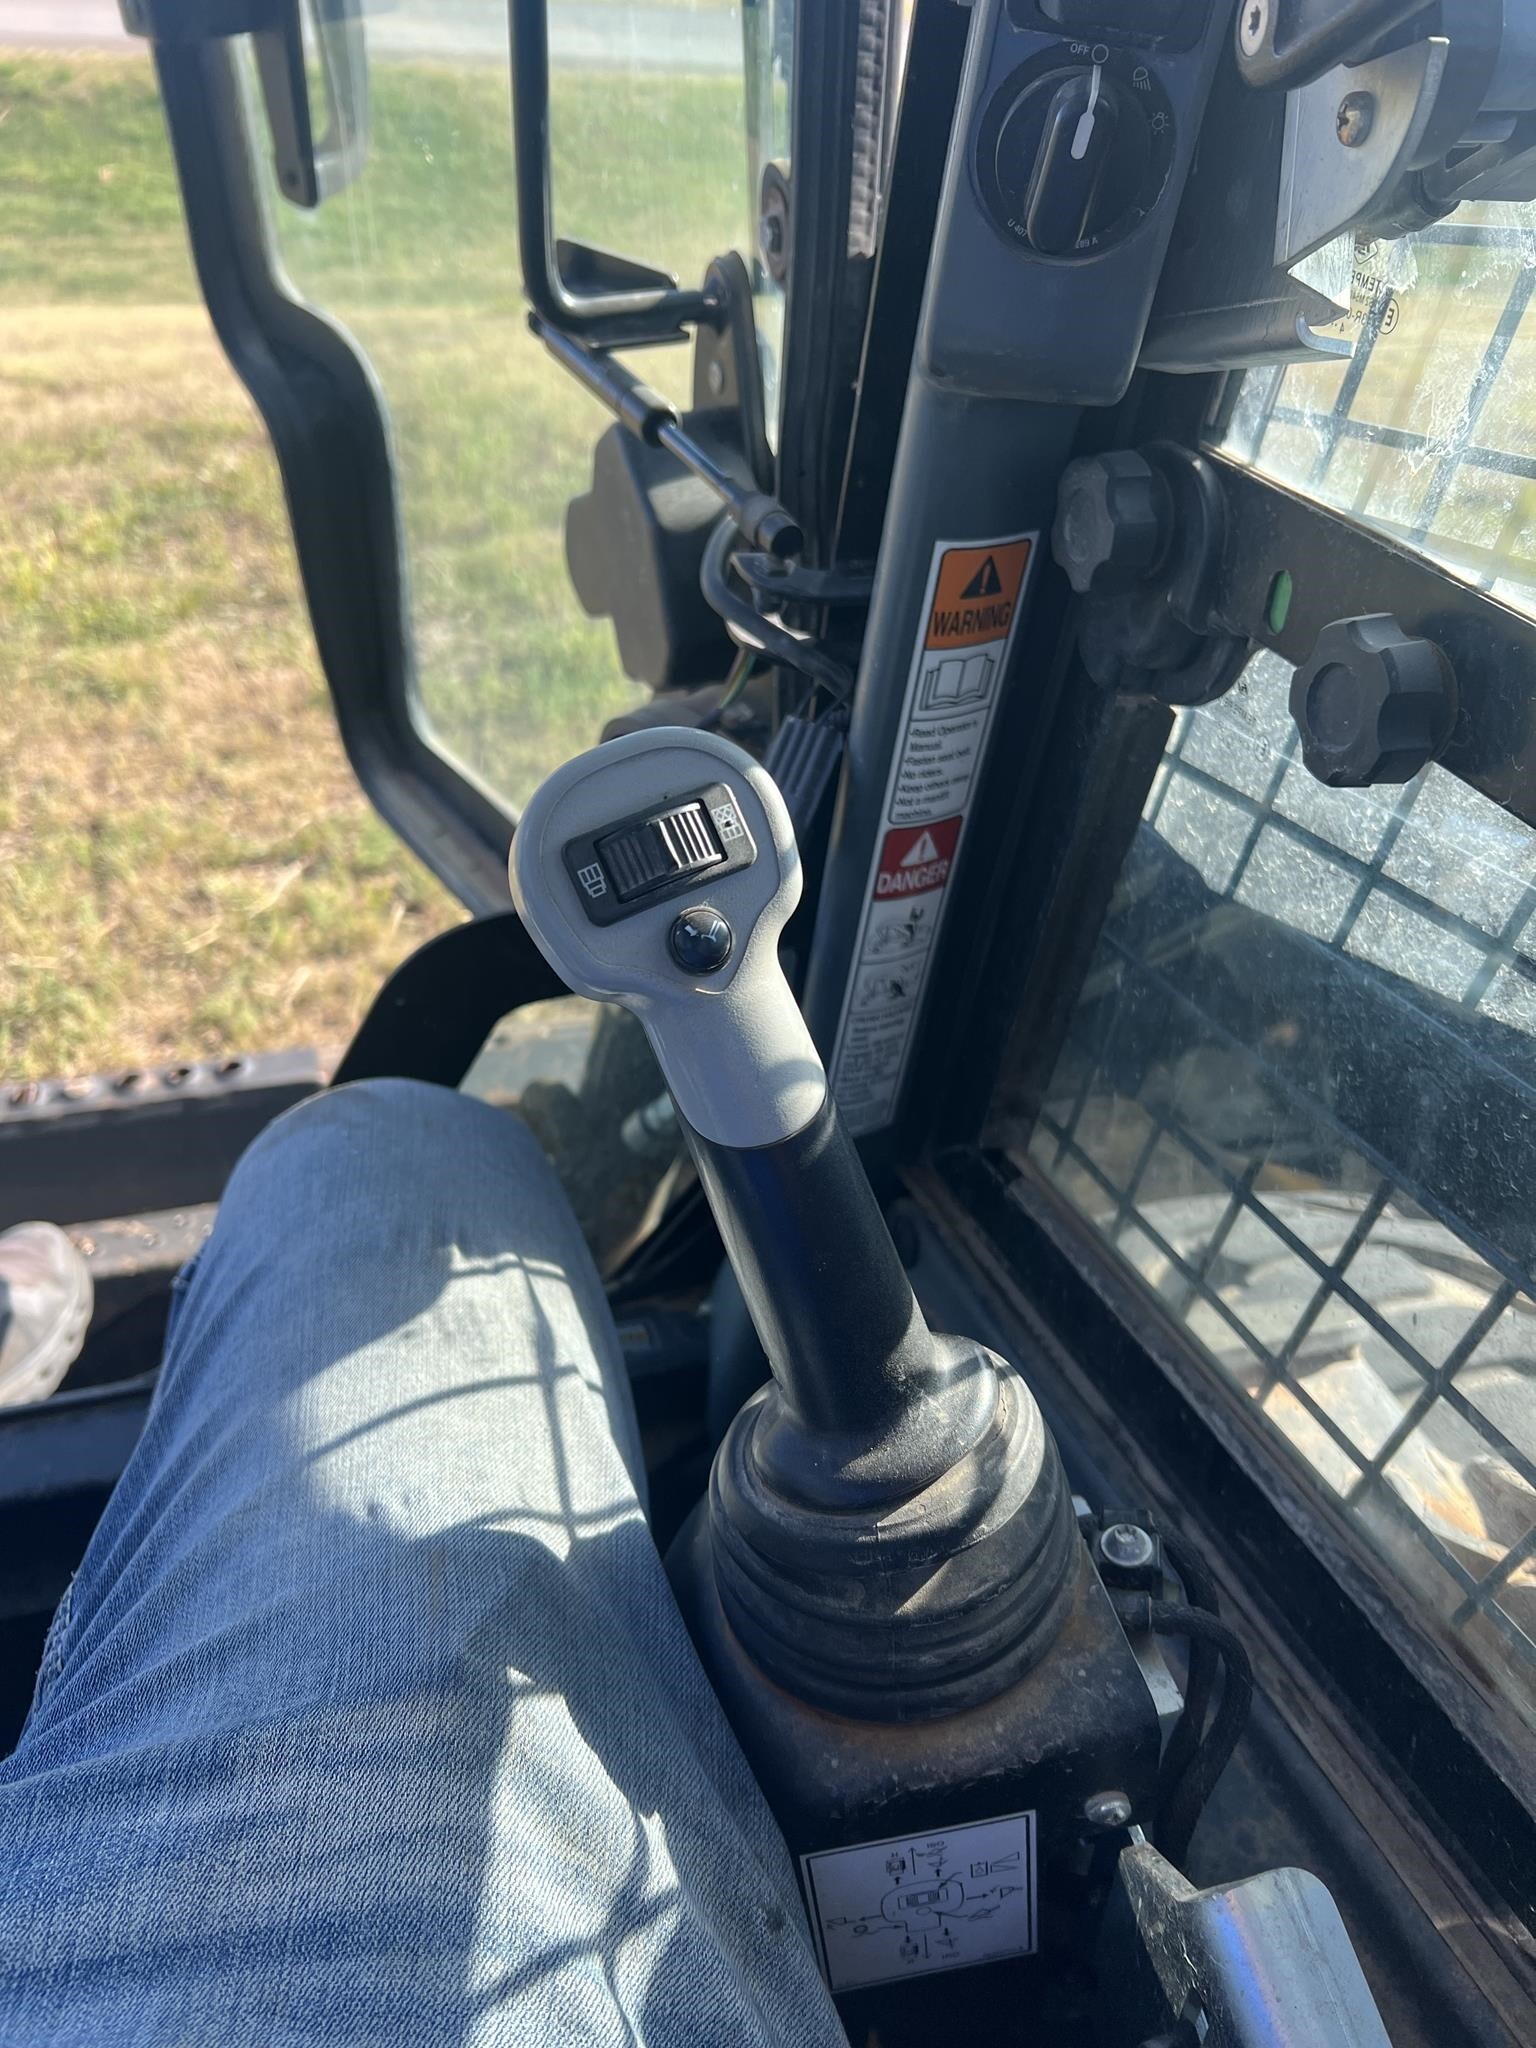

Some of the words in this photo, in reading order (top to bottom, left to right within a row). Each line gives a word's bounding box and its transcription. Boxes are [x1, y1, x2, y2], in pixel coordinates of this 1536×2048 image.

[1070, 43, 1090, 55] OFF
[932, 601, 1012, 637] WARNING
[877, 858, 950, 894] DANGER
